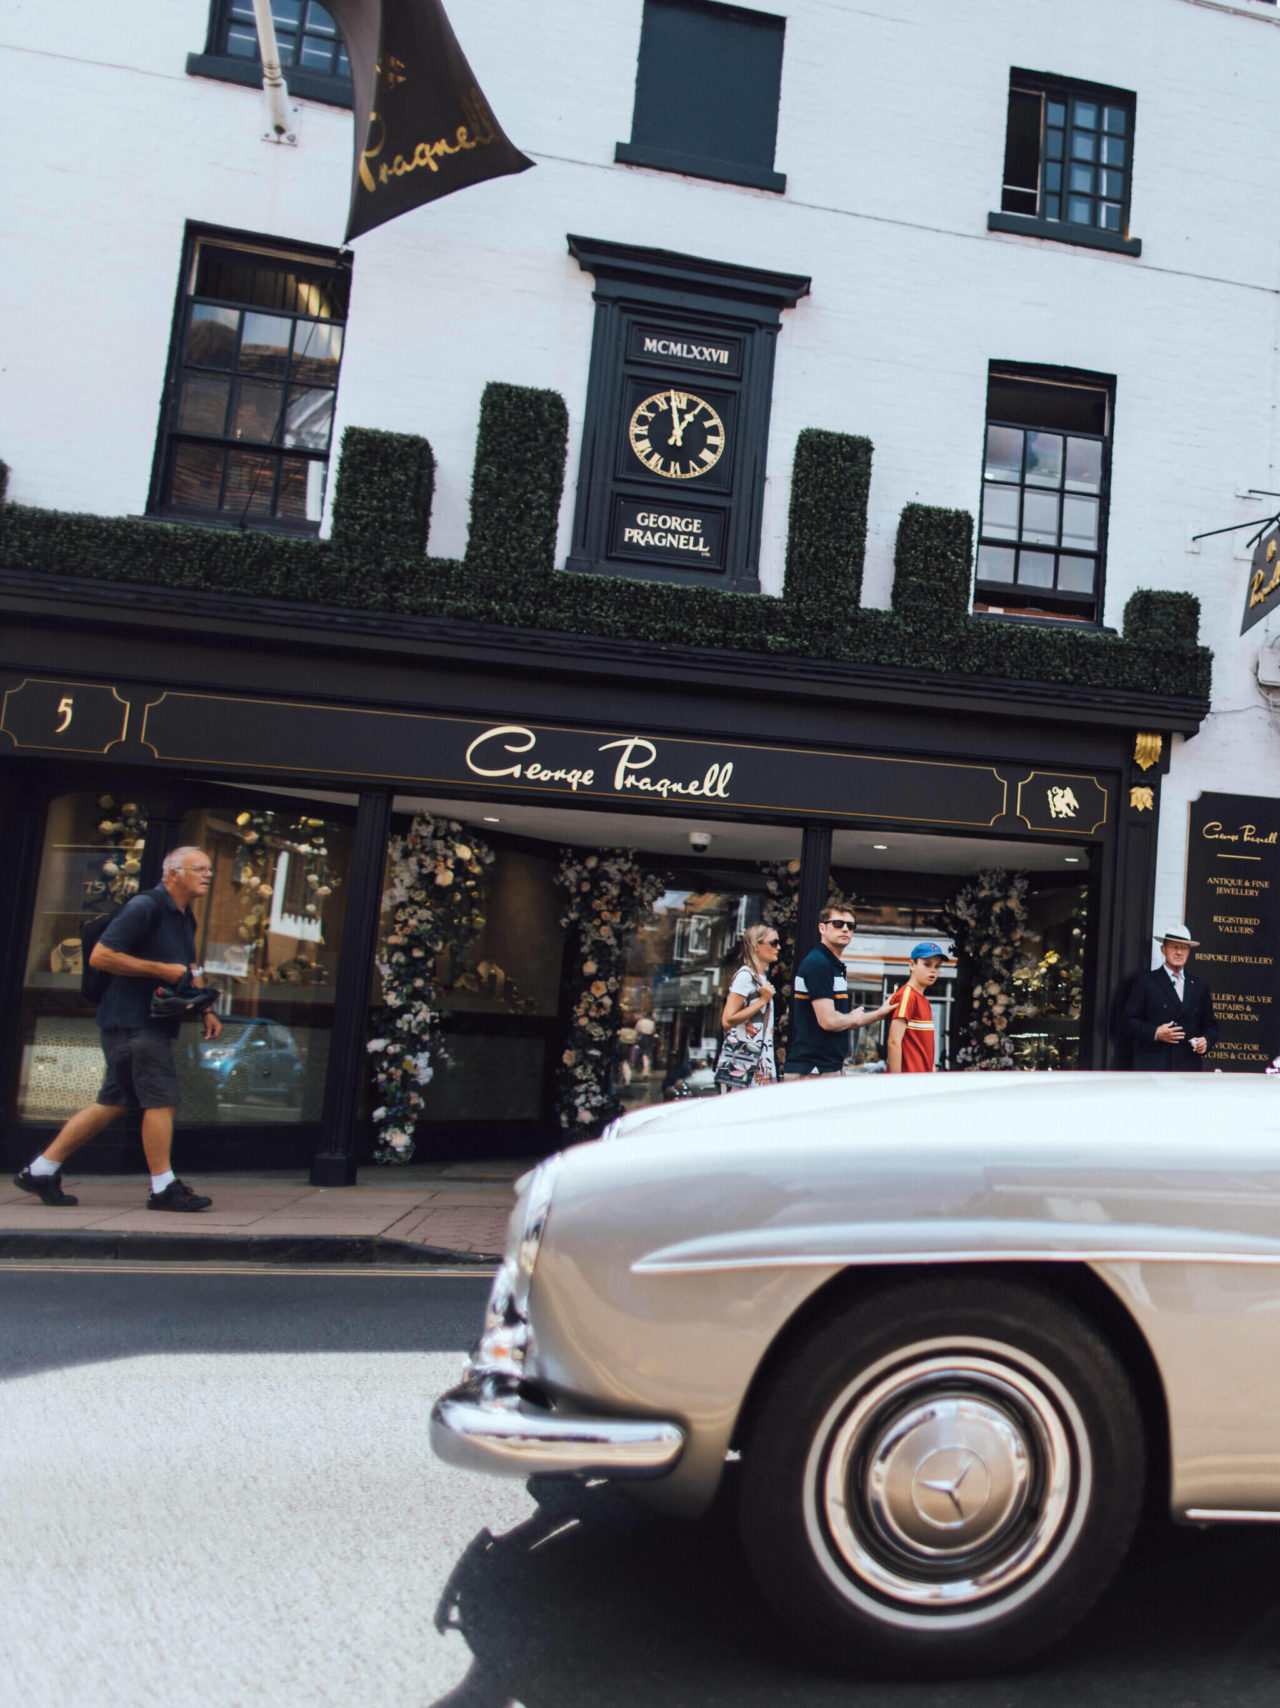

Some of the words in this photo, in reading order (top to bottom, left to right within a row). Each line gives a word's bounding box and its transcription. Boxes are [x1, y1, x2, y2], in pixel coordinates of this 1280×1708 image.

[643, 337, 729, 364] MCMLXXVII
[636, 512, 702, 533] GEORGE
[623, 527, 710, 552] PRAGNELL
[55, 697, 73, 733] 5
[466, 725, 594, 790] George
[598, 736, 734, 797] Pragnell
[1202, 821, 1239, 842] George
[1239, 824, 1278, 844] Pragnell
[1207, 877, 1242, 887] ANTIQUE
[1252, 880, 1270, 888] FINE
[1216, 887, 1259, 896] JEWELLERY
[1213, 915, 1260, 926] REGISTERED
[1218, 925, 1254, 935] VALUERS
[1195, 953, 1229, 962] BESPOKE
[1230, 955, 1274, 965] JEWELLERY
[1245, 995, 1272, 1003] SILVER
[1213, 1003, 1244, 1011] REPAIRS
[1244, 1043, 1259, 1051] FOR
[1237, 1053, 1269, 1061] CLOCKS
